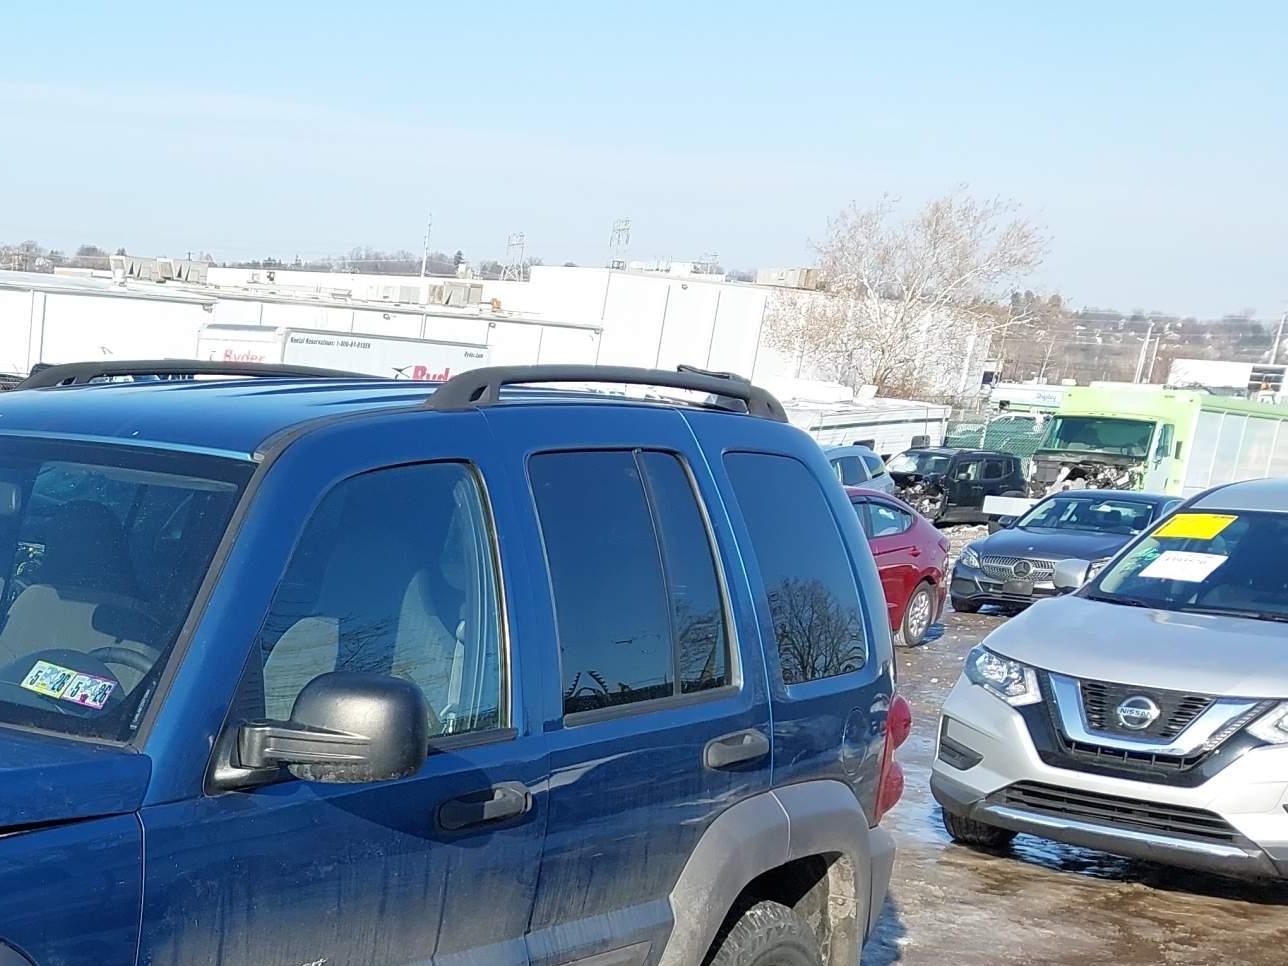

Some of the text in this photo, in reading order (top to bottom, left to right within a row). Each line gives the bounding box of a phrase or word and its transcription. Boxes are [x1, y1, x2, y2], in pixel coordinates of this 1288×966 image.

[412, 365, 451, 381] Ryd
[29, 670, 71, 692] 5 26
[70, 681, 112, 703] 5 26
